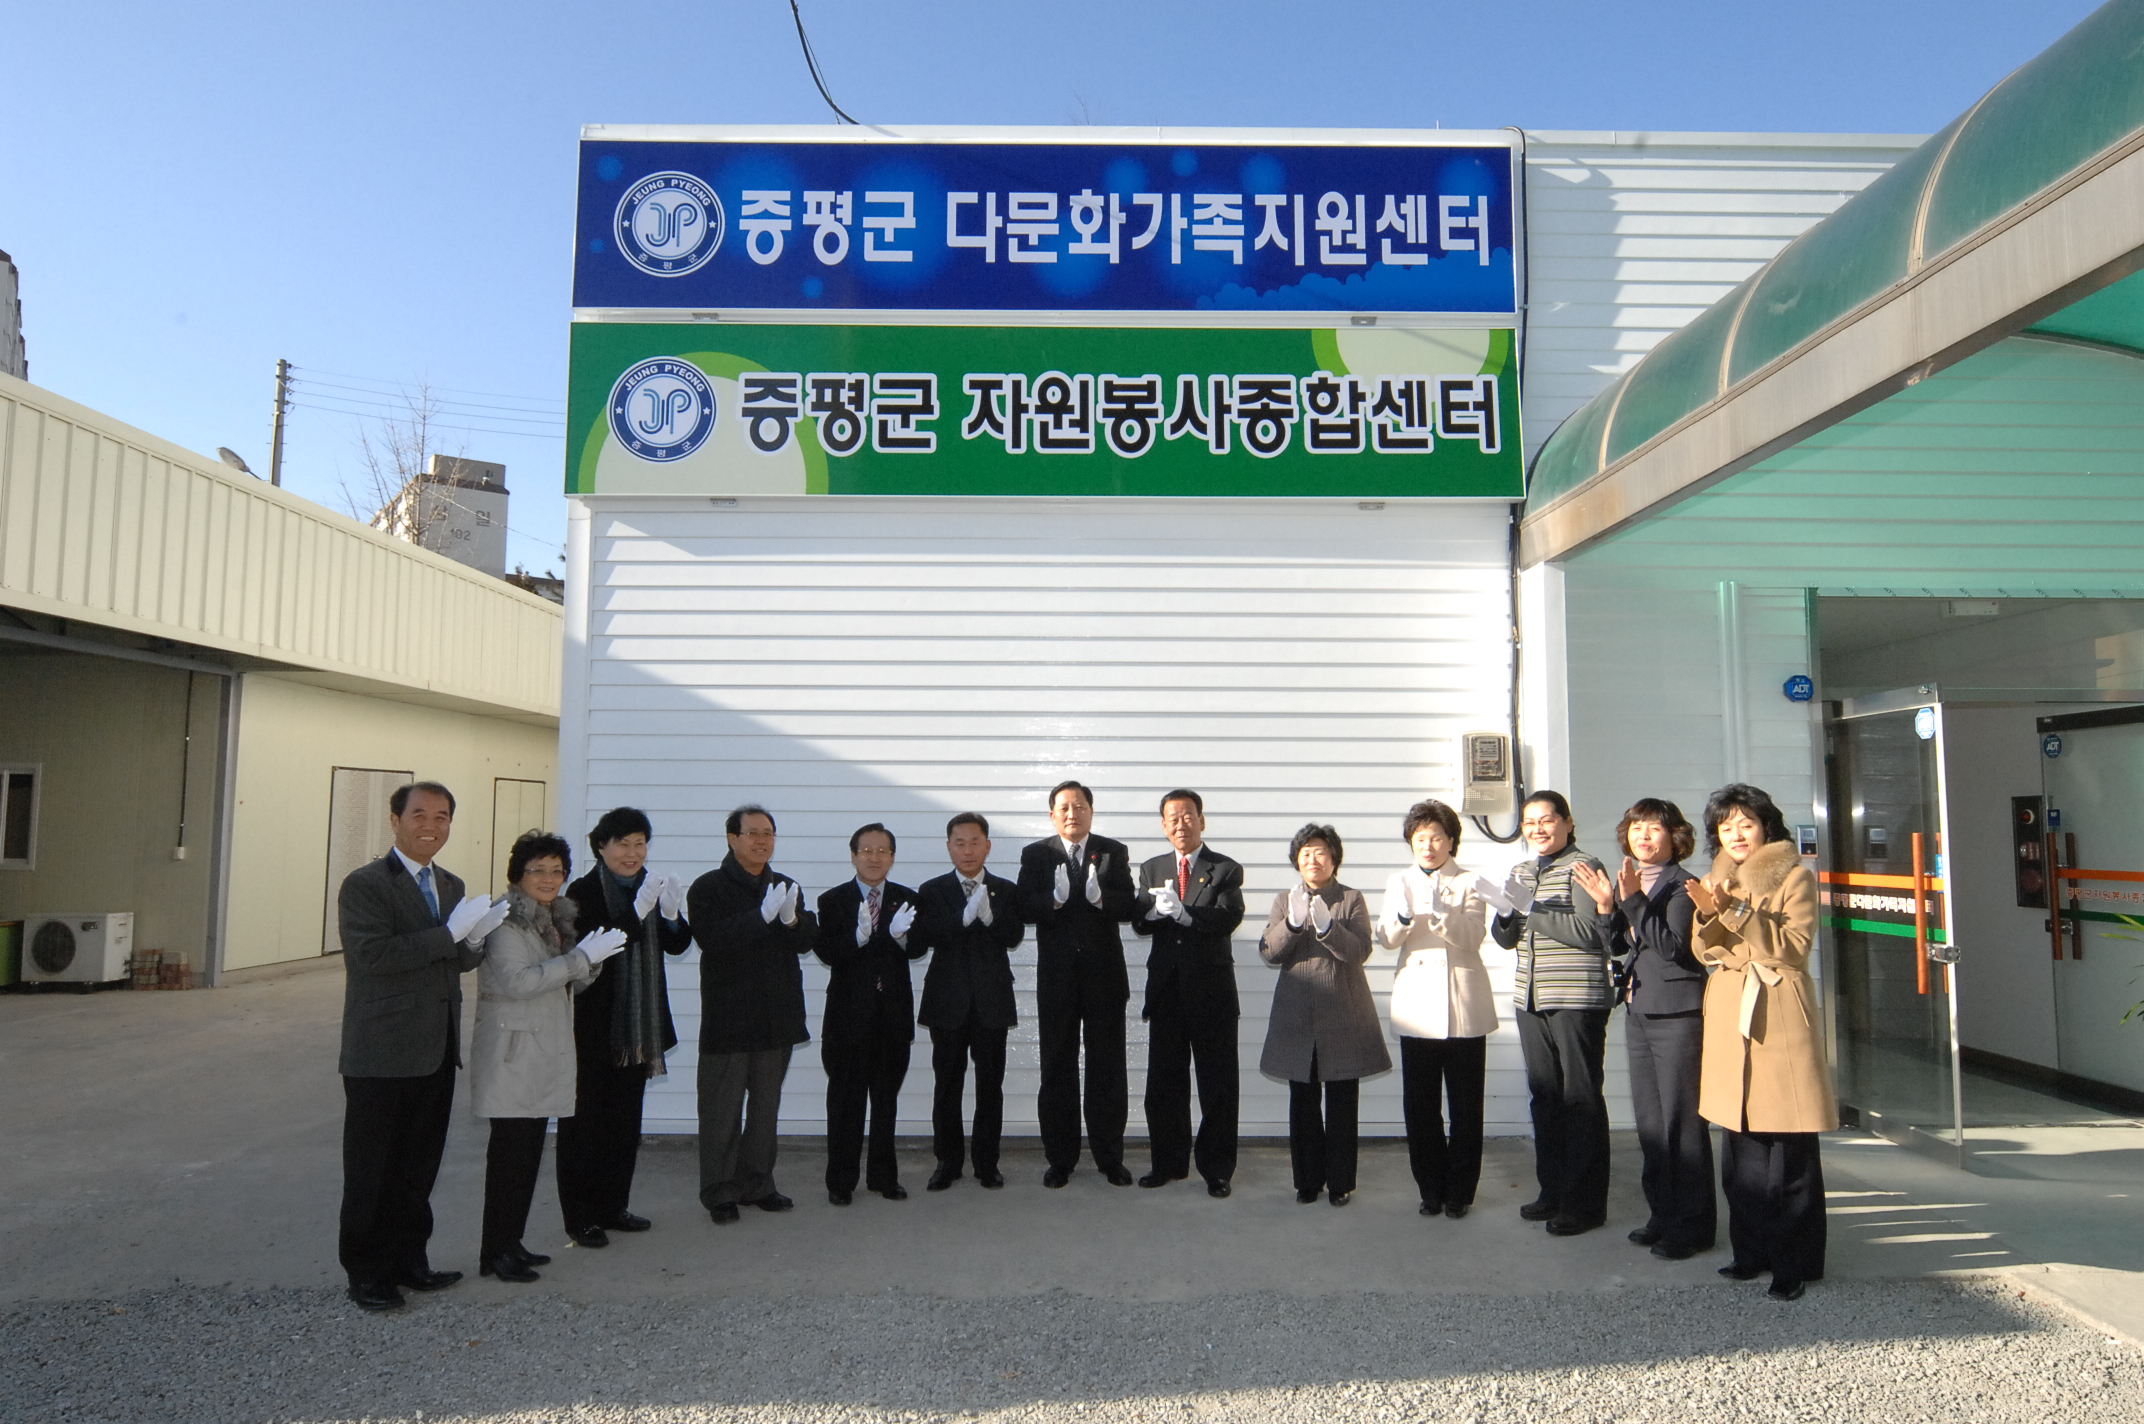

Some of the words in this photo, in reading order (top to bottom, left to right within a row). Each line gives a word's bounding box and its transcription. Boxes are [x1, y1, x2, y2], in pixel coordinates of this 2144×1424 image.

[632, 180, 665, 205] JEUNG
[671, 179, 711, 206] PYEONG
[739, 189, 917, 266] 증평군
[946, 189, 1490, 267] 다문화가족지원센터
[625, 365, 658, 391] JEUNG
[664, 364, 705, 392] PYEONG
[739, 373, 939, 457] 증평군
[963, 371, 1501, 458] 자원봉사종합센터
[1793, 684, 1810, 694] ADT
[2046, 741, 2059, 751] ADT
[2067, 887, 2144, 905] 증평군자원봉사종
